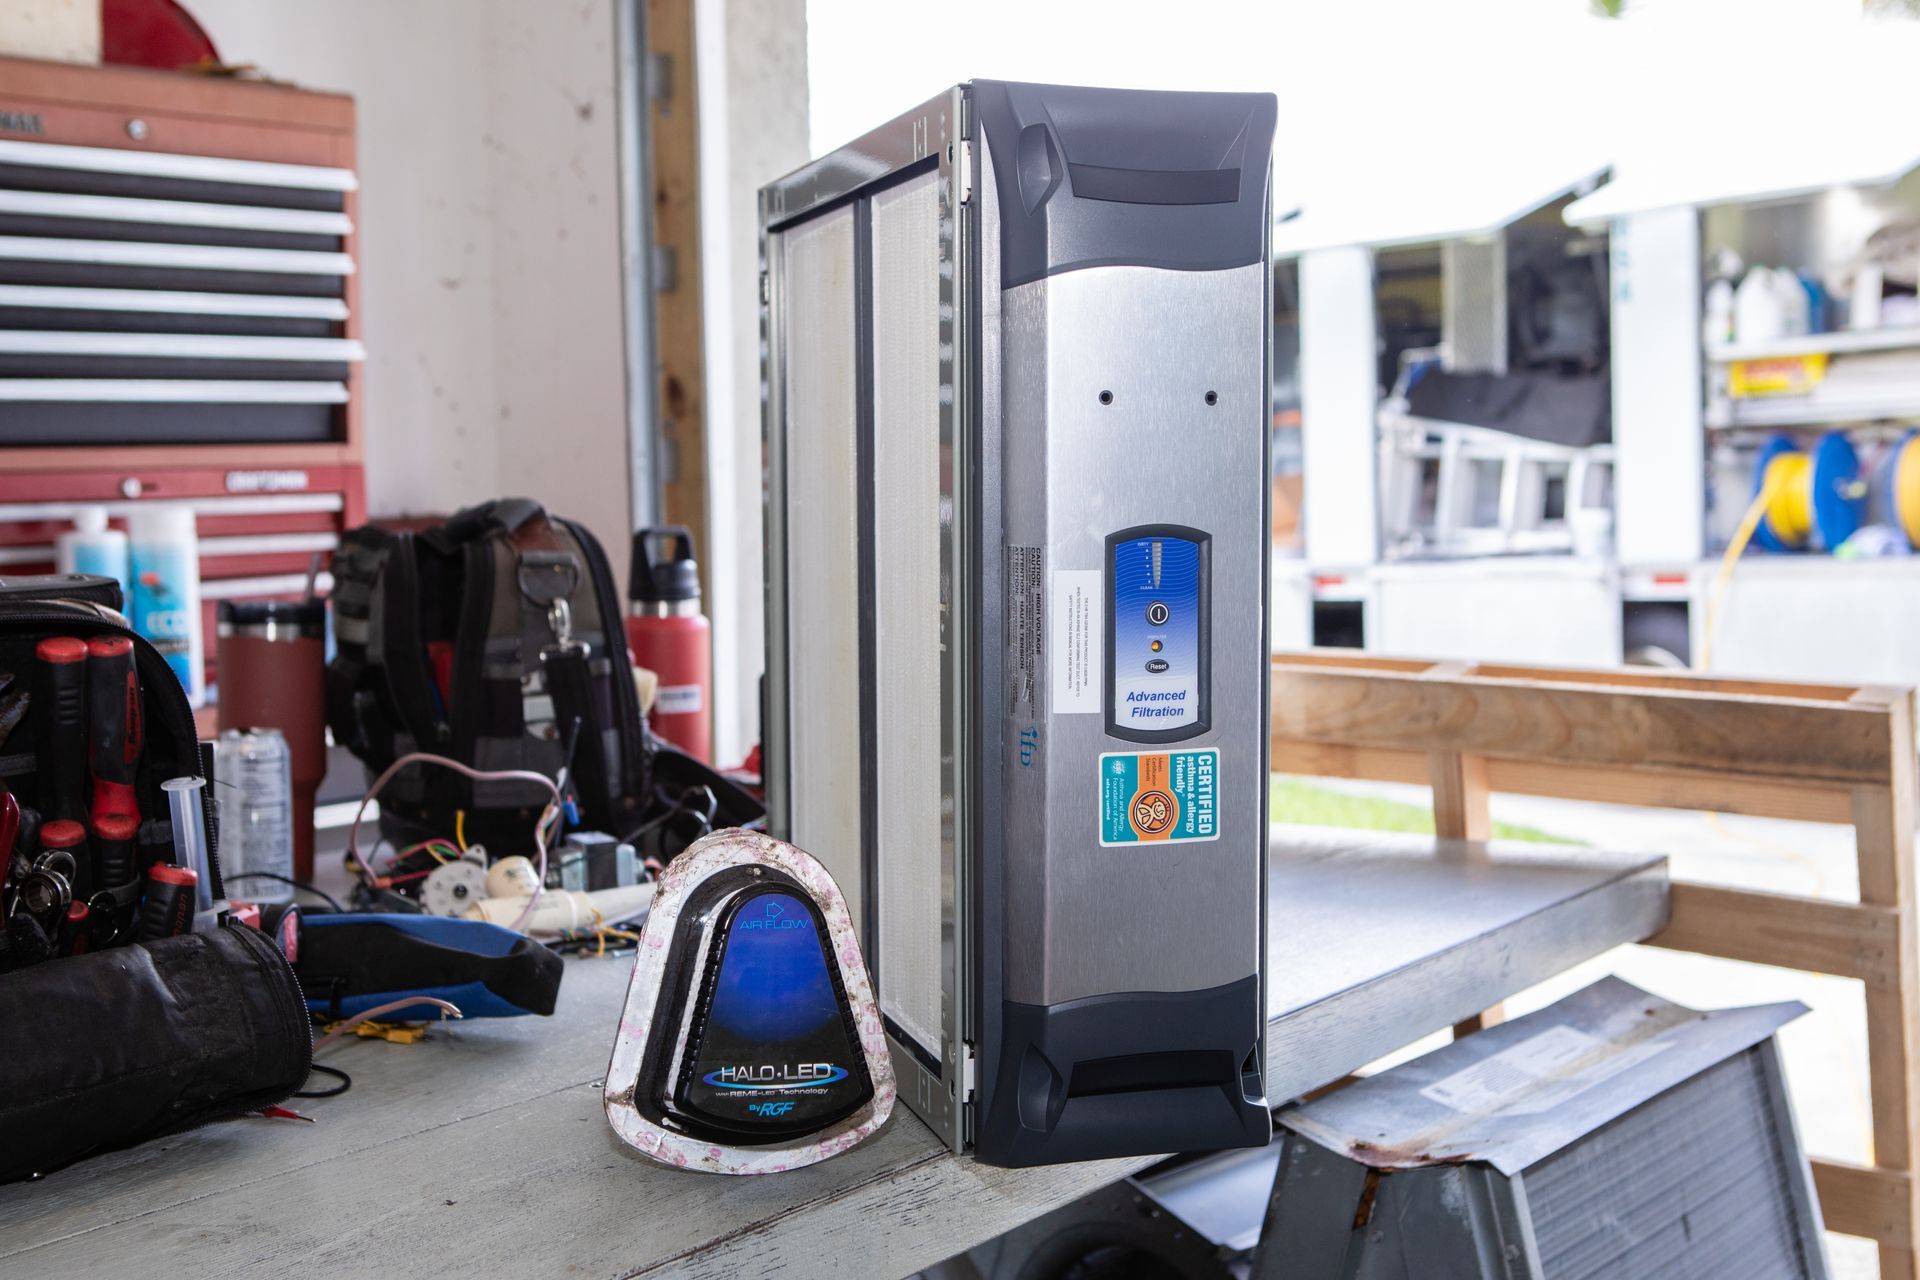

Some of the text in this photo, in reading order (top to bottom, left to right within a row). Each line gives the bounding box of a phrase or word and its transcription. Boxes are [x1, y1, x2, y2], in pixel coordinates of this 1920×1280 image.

[1126, 690, 1186, 702] Advanced
[1131, 706, 1184, 718] Filtration
[1186, 755, 1197, 834] asthma & allergy
[1198, 754, 1213, 834] CERTIFIED
[740, 919, 808, 929] AIR FLOW
[779, 1088, 828, 1096] Technology
[749, 1102, 795, 1117] By RGF
